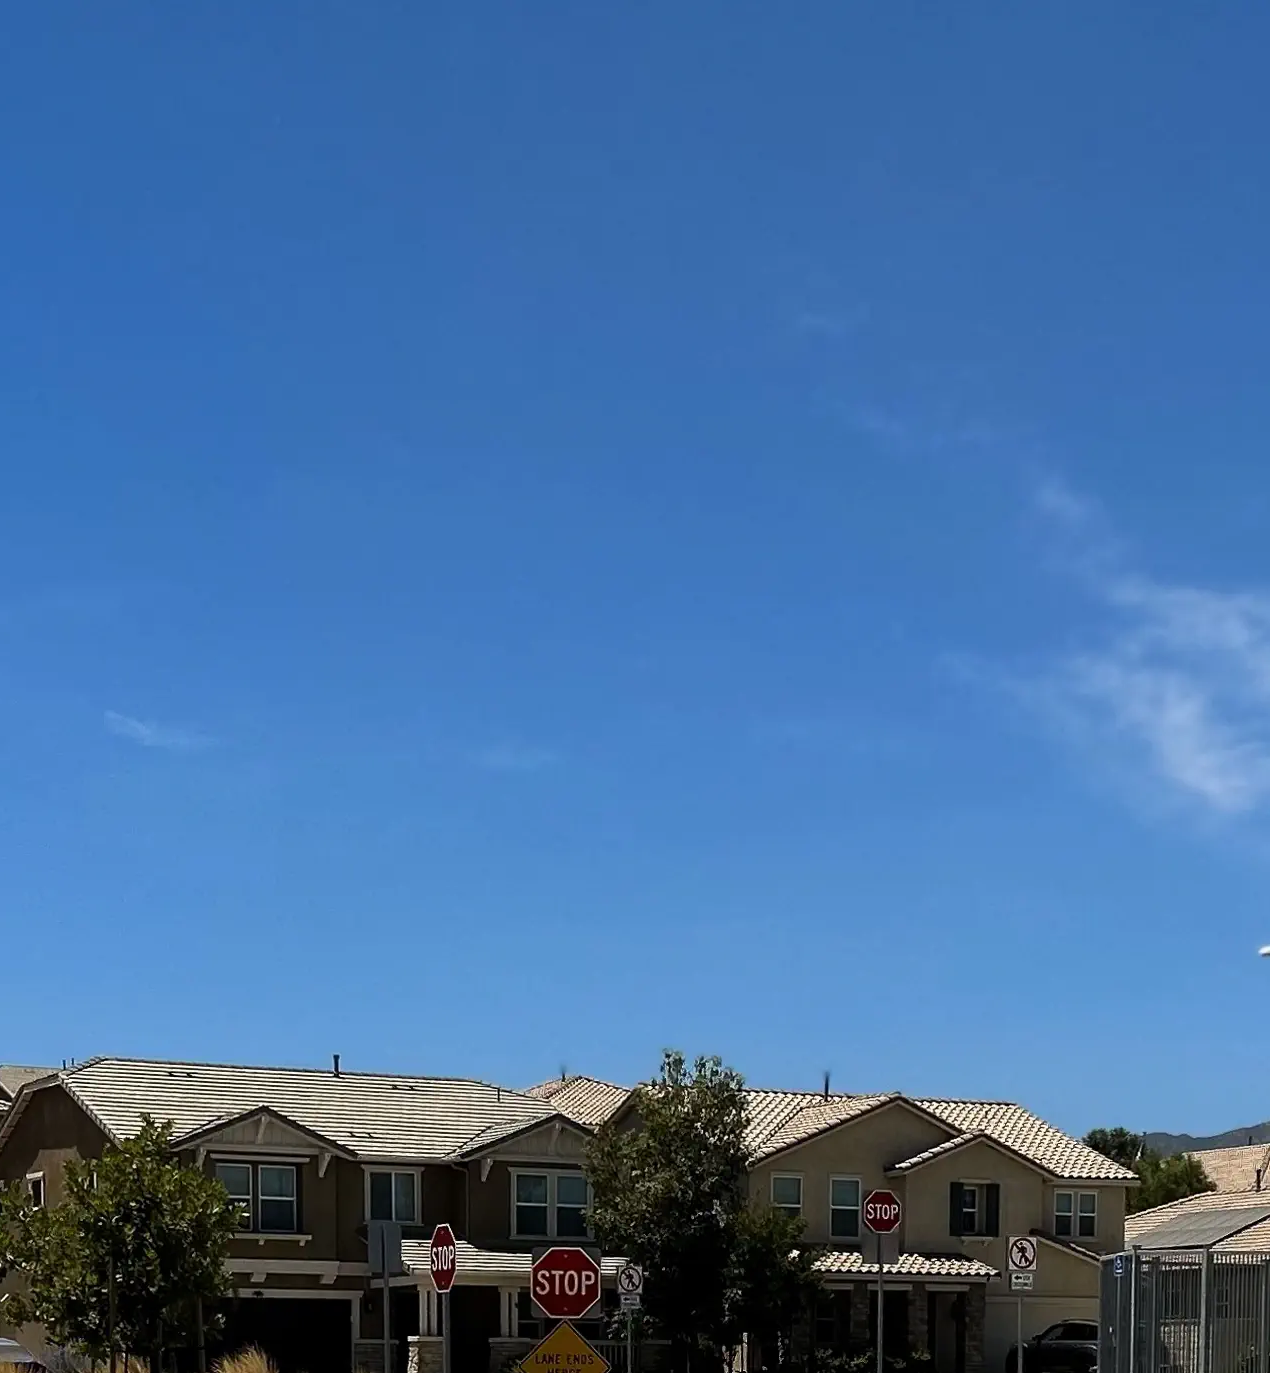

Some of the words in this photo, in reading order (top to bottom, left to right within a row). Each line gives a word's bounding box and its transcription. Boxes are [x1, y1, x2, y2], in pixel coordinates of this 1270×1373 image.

[867, 1203, 899, 1220] STOP
[431, 1245, 455, 1272] STOP
[535, 1270, 596, 1296] STOP
[534, 1353, 561, 1366] LANE
[566, 1353, 595, 1366] ENDS
